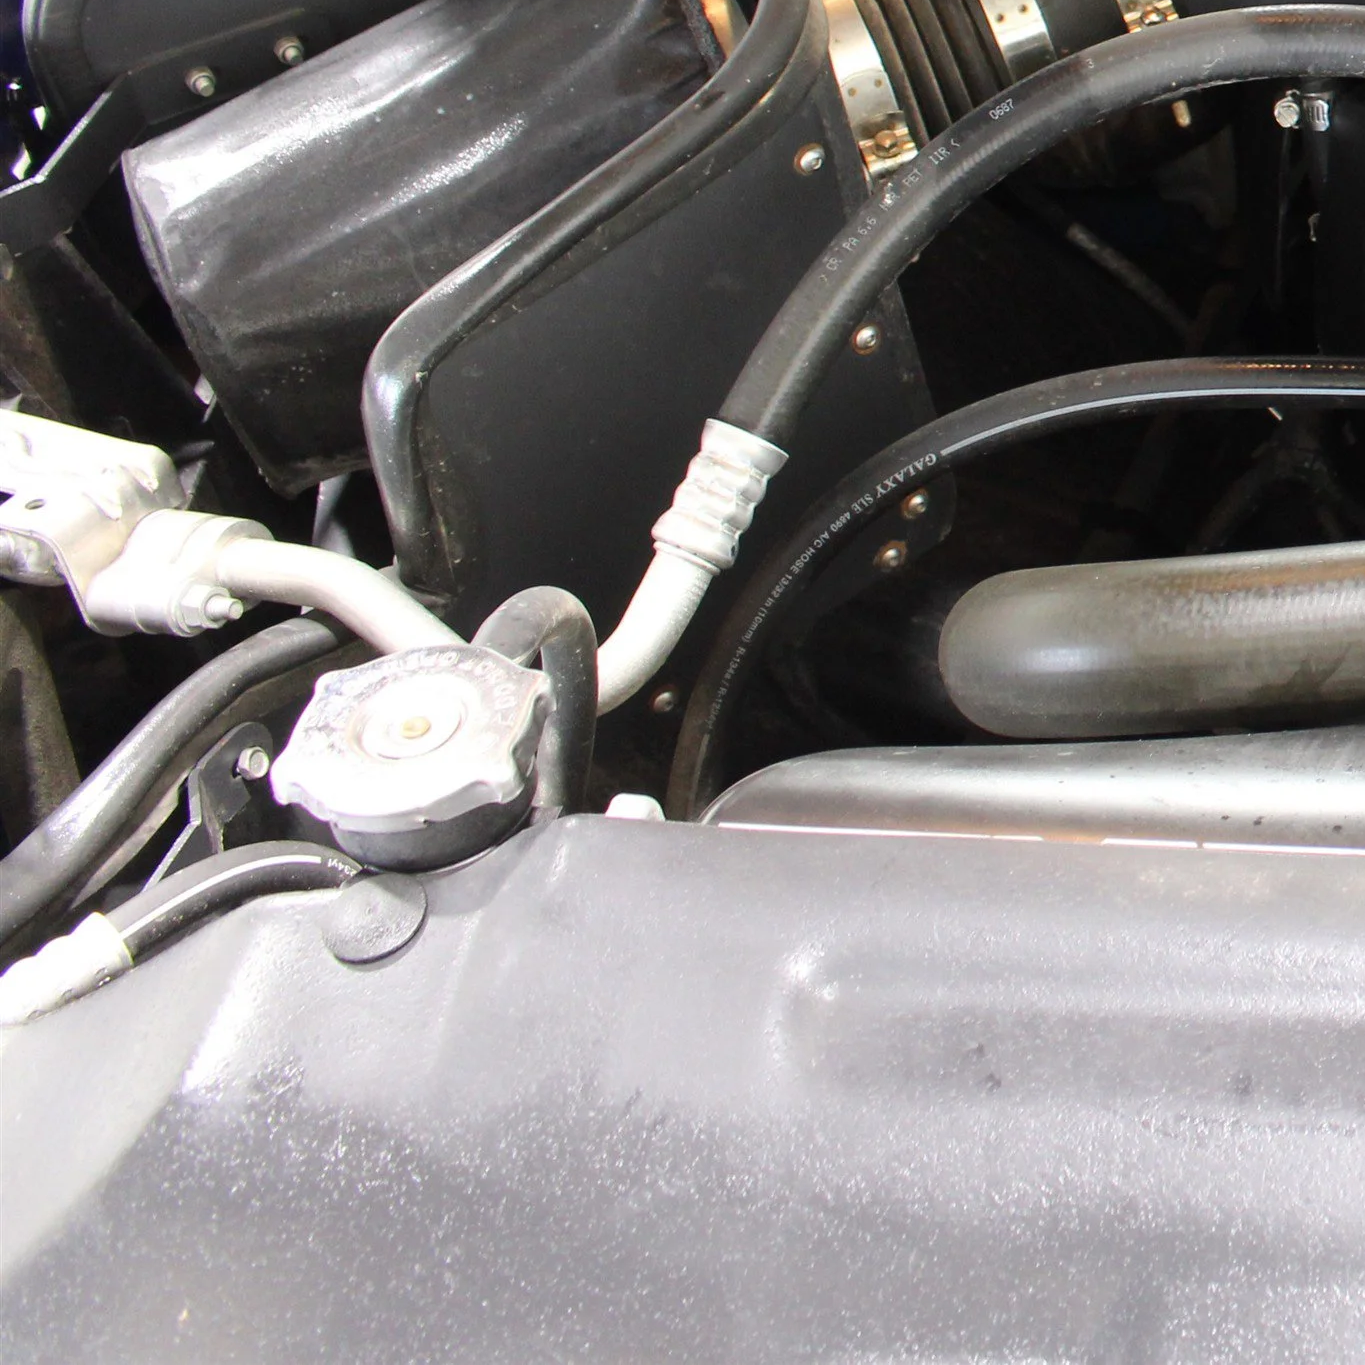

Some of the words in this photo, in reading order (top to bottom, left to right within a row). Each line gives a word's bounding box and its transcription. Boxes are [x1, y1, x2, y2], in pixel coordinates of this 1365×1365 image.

[988, 98, 1016, 122] 0687
[875, 452, 938, 499] GALAXY
[851, 493, 874, 515] SLE
[813, 531, 830, 549] A/C
[790, 546, 816, 575] HOSE
